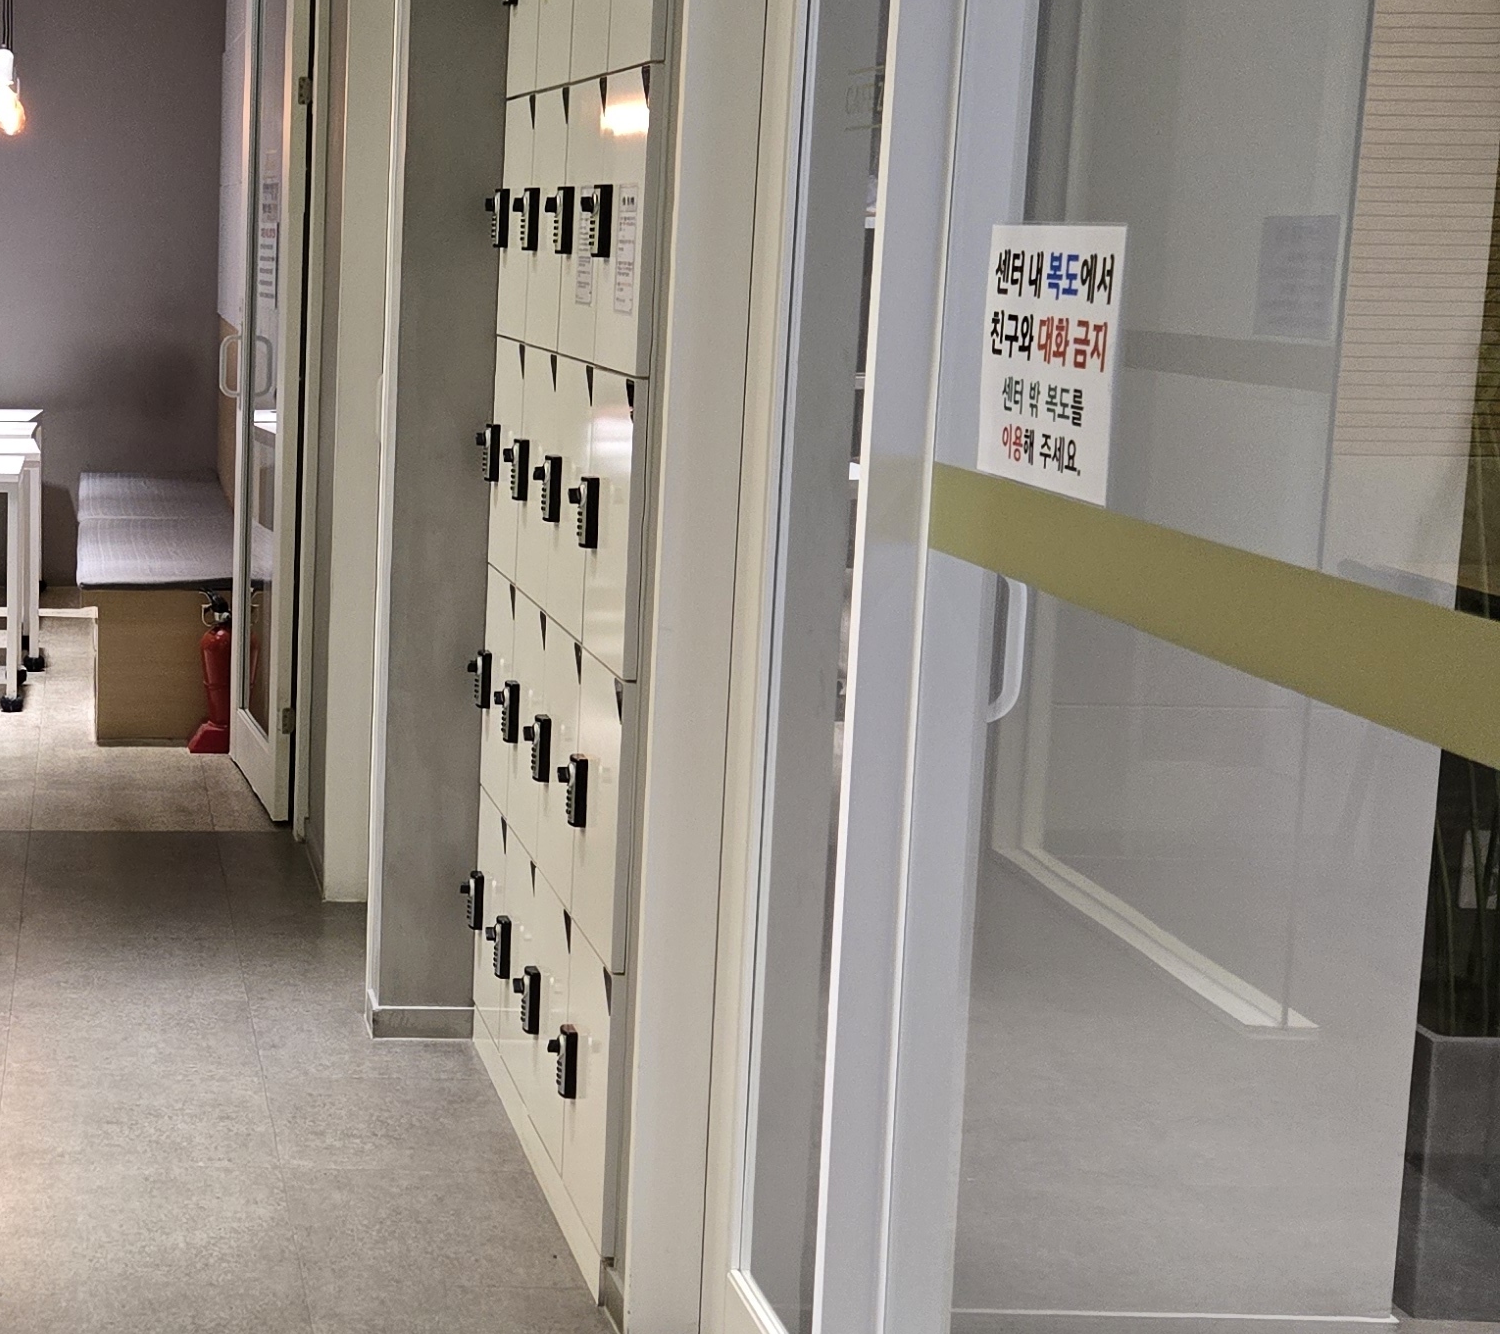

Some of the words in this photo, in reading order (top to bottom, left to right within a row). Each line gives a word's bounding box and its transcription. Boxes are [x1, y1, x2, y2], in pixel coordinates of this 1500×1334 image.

[995, 248, 1026, 298] 센터
[1028, 250, 1045, 300] 내
[1046, 251, 1116, 306] 복도에서
[990, 309, 1034, 361] 친구와
[1037, 315, 1070, 367] 대화
[1073, 319, 1109, 373] 금지
[1002, 376, 1024, 415] 센터
[1029, 380, 1041, 419] 밖
[1044, 383, 1085, 428] 복도를
[1002, 423, 1035, 466] 이용해
[1038, 432, 1082, 477] 주세요.
